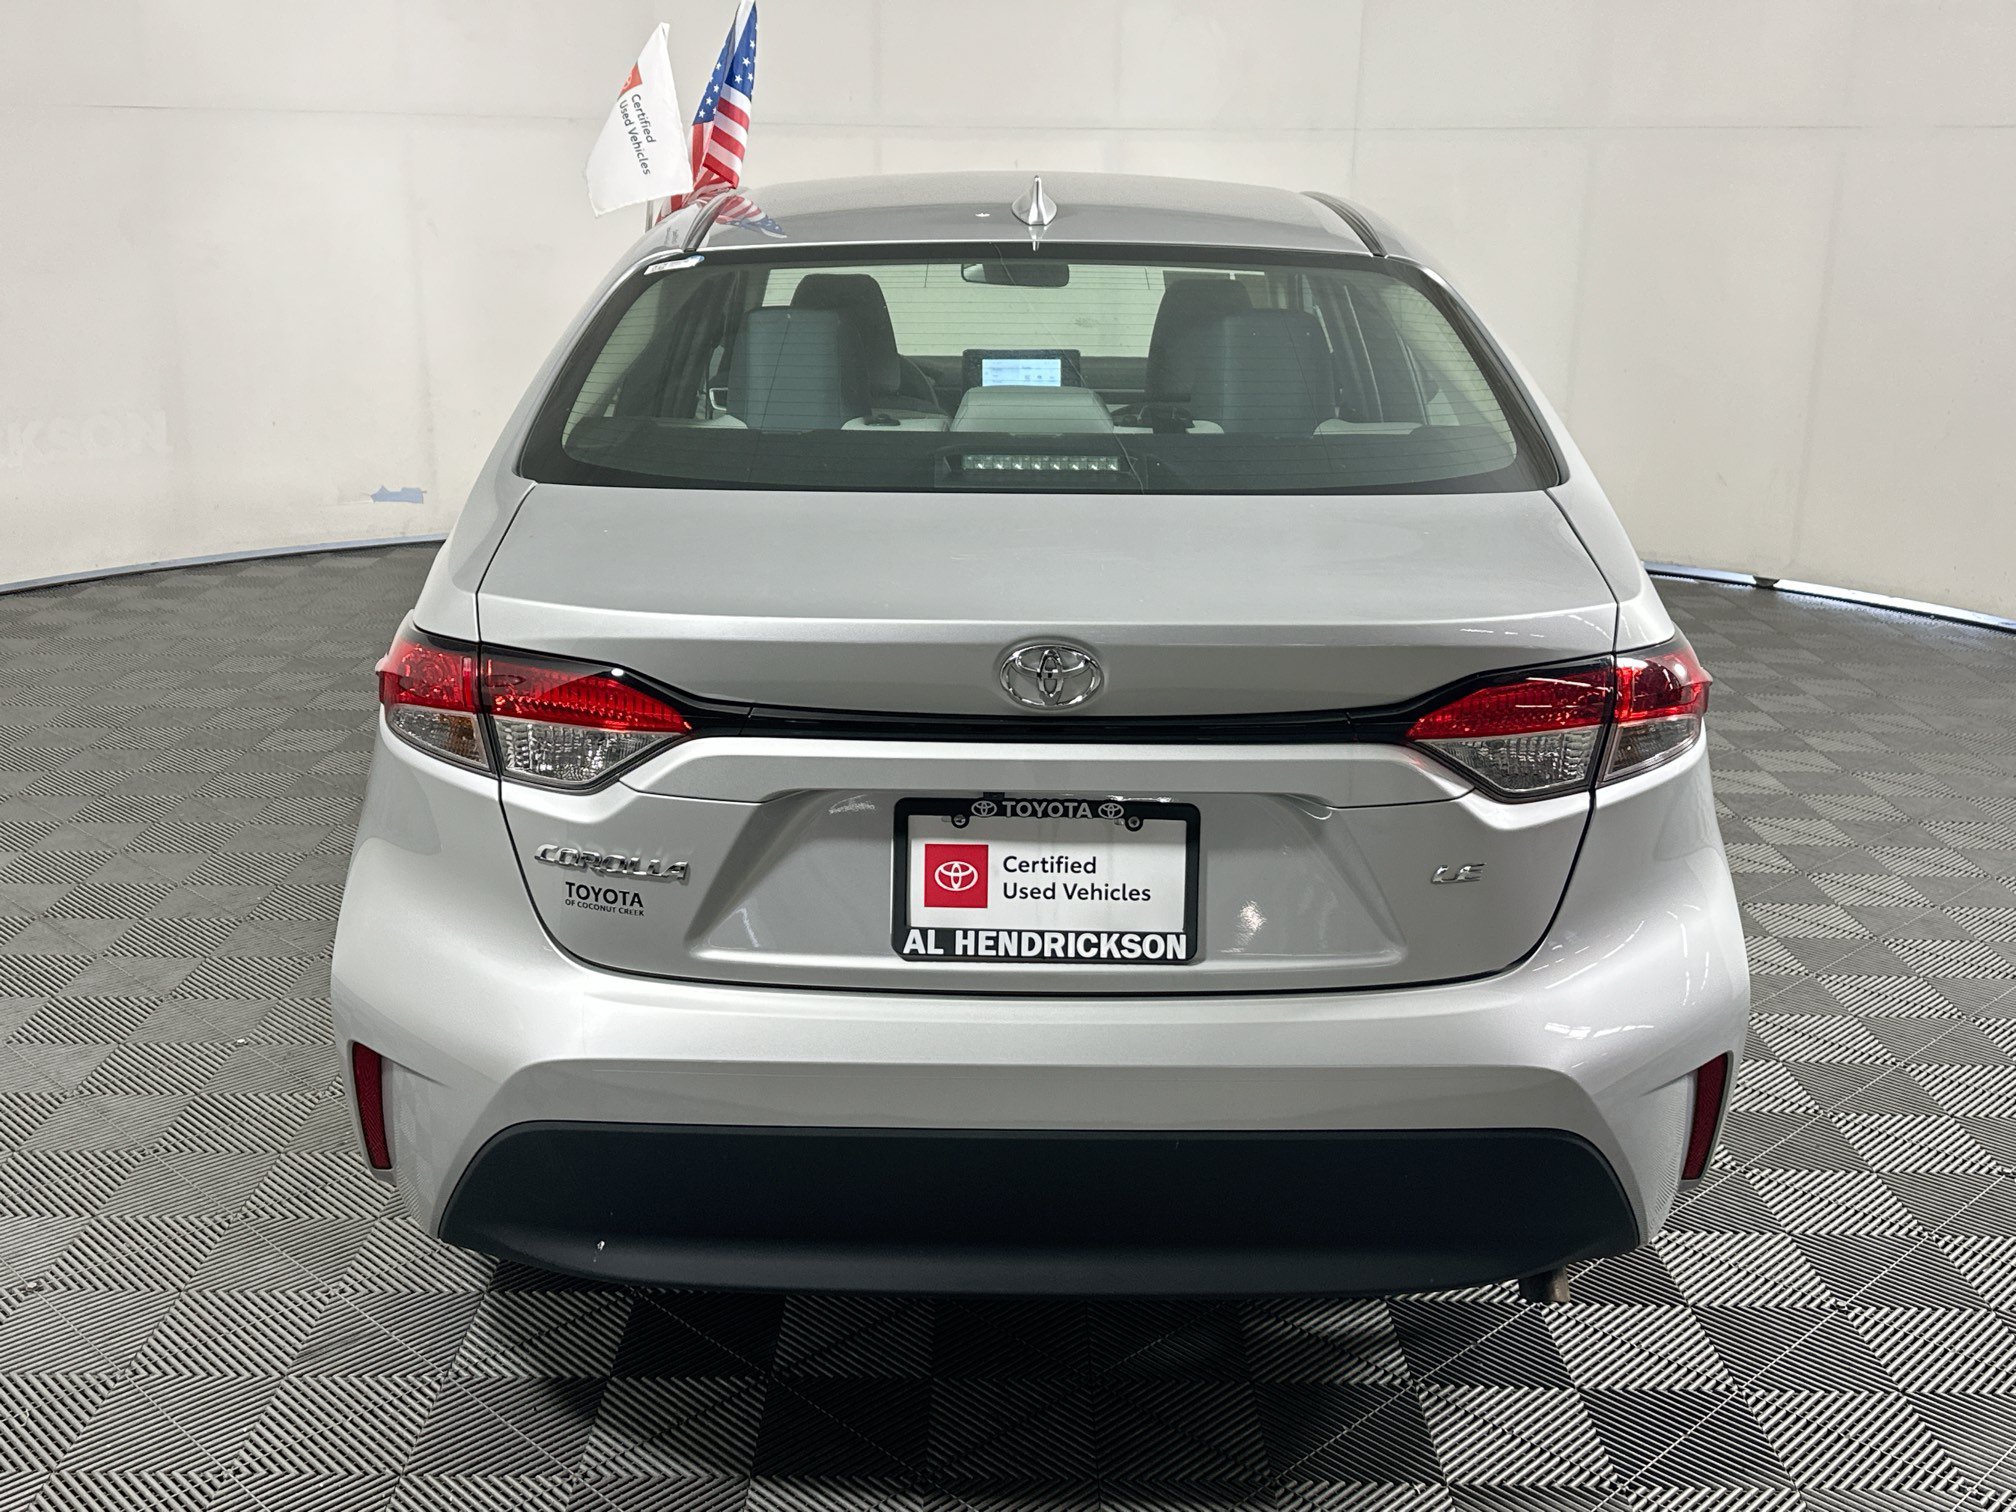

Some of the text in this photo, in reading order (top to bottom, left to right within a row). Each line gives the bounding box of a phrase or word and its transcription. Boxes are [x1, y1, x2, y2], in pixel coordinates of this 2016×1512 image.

[631, 94, 656, 143] Certified
[619, 100, 650, 175] Used Vehicles
[1002, 801, 1093, 819] TOYOTA
[534, 843, 689, 882] COROLLA
[1003, 856, 1097, 874] Certified
[1431, 862, 1487, 884] LE
[565, 881, 644, 908] TOYOTA
[1003, 882, 1151, 902] Used Vehicles
[565, 899, 645, 917] OF COCONUT CREEK
[903, 929, 1187, 960] AL HENDRICKSON
